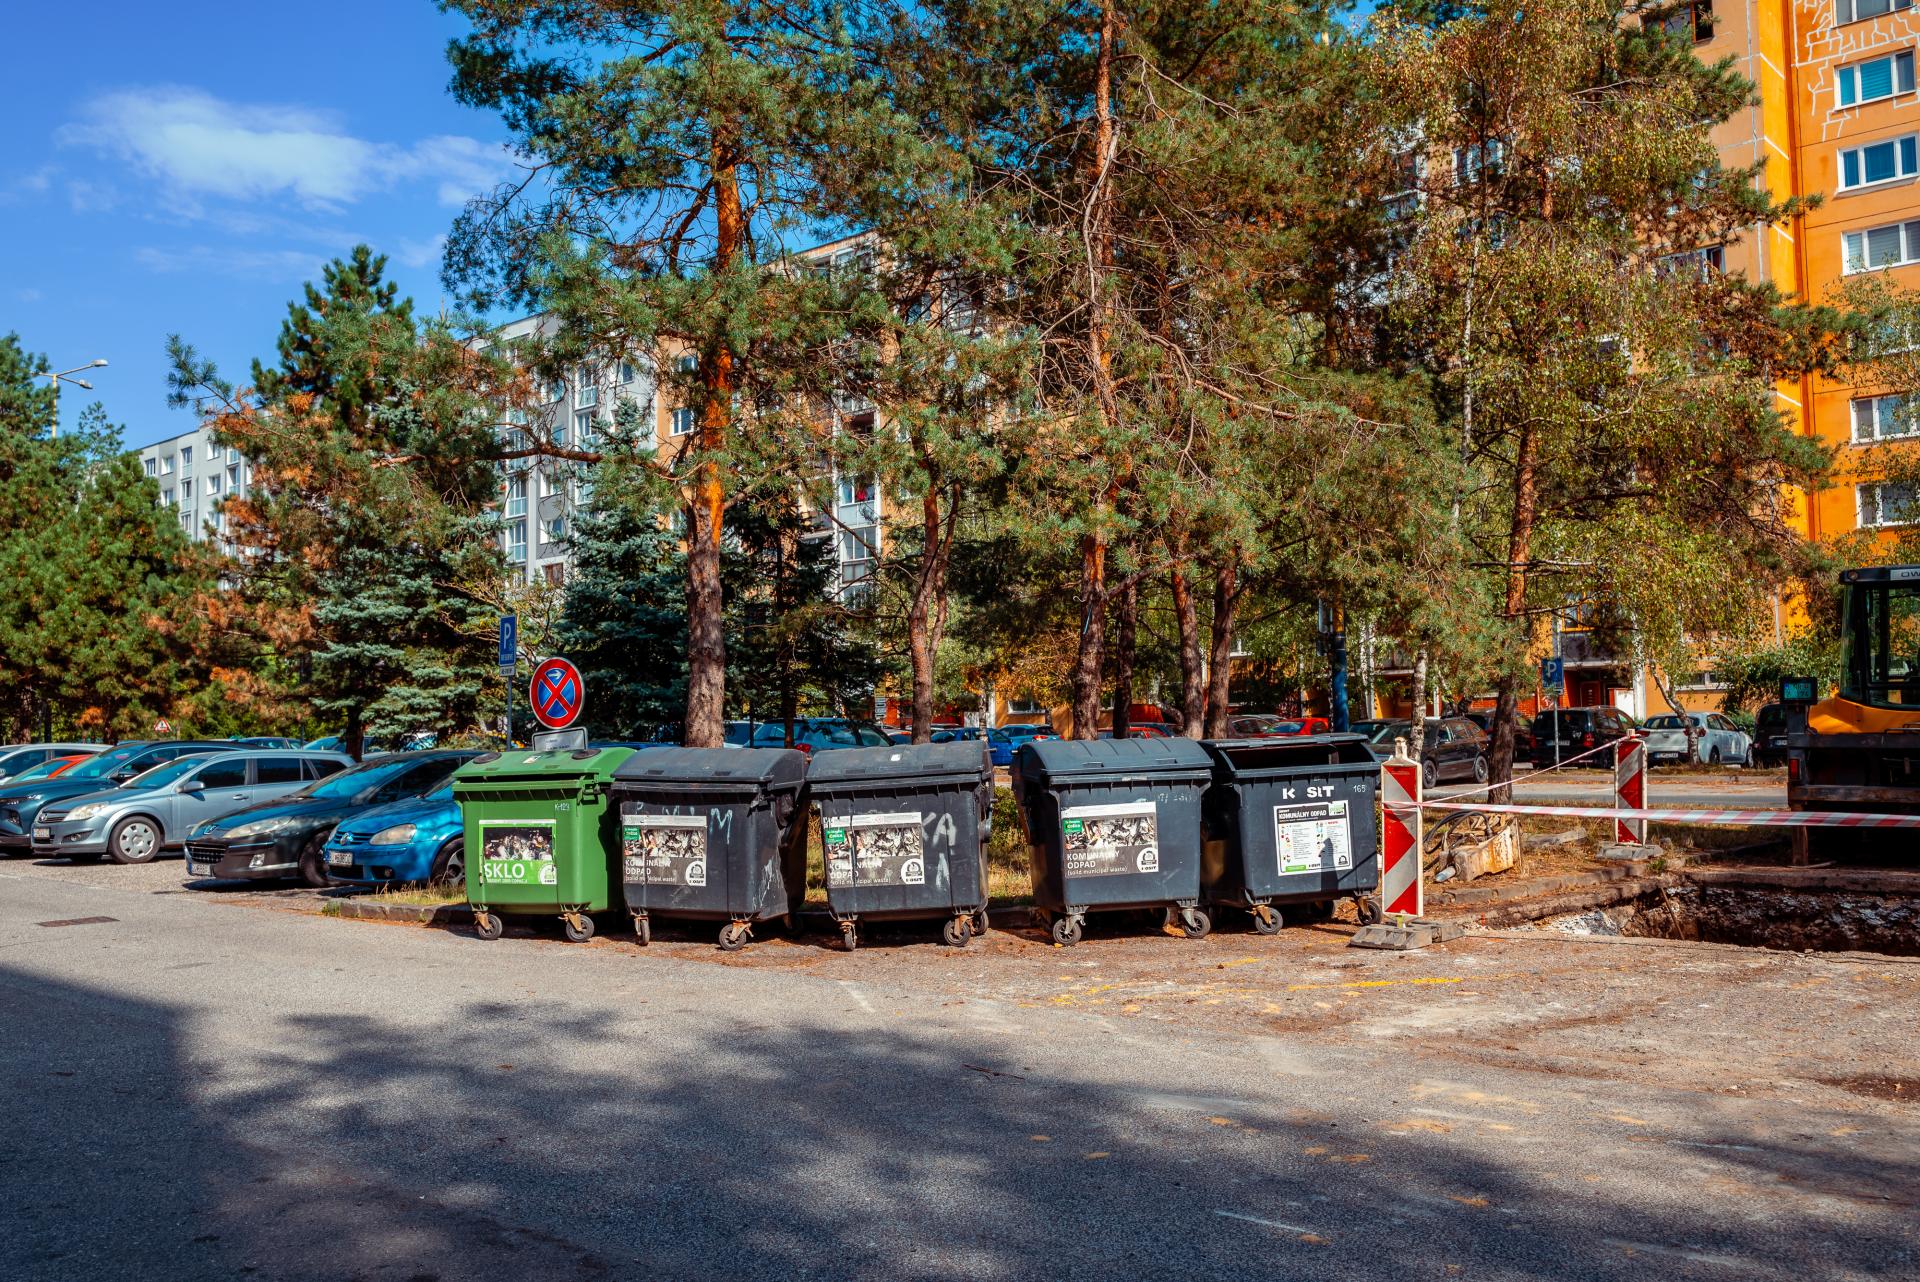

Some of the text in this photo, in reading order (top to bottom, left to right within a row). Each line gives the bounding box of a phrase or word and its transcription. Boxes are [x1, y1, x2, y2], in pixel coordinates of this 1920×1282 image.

[503, 623, 511, 649] P
[1547, 661, 1557, 677] P
[1353, 784, 1366, 793] 165
[484, 863, 525, 879] SKLO
[625, 867, 652, 875] ODPAD
[1067, 860, 1096, 870] ODPAD
